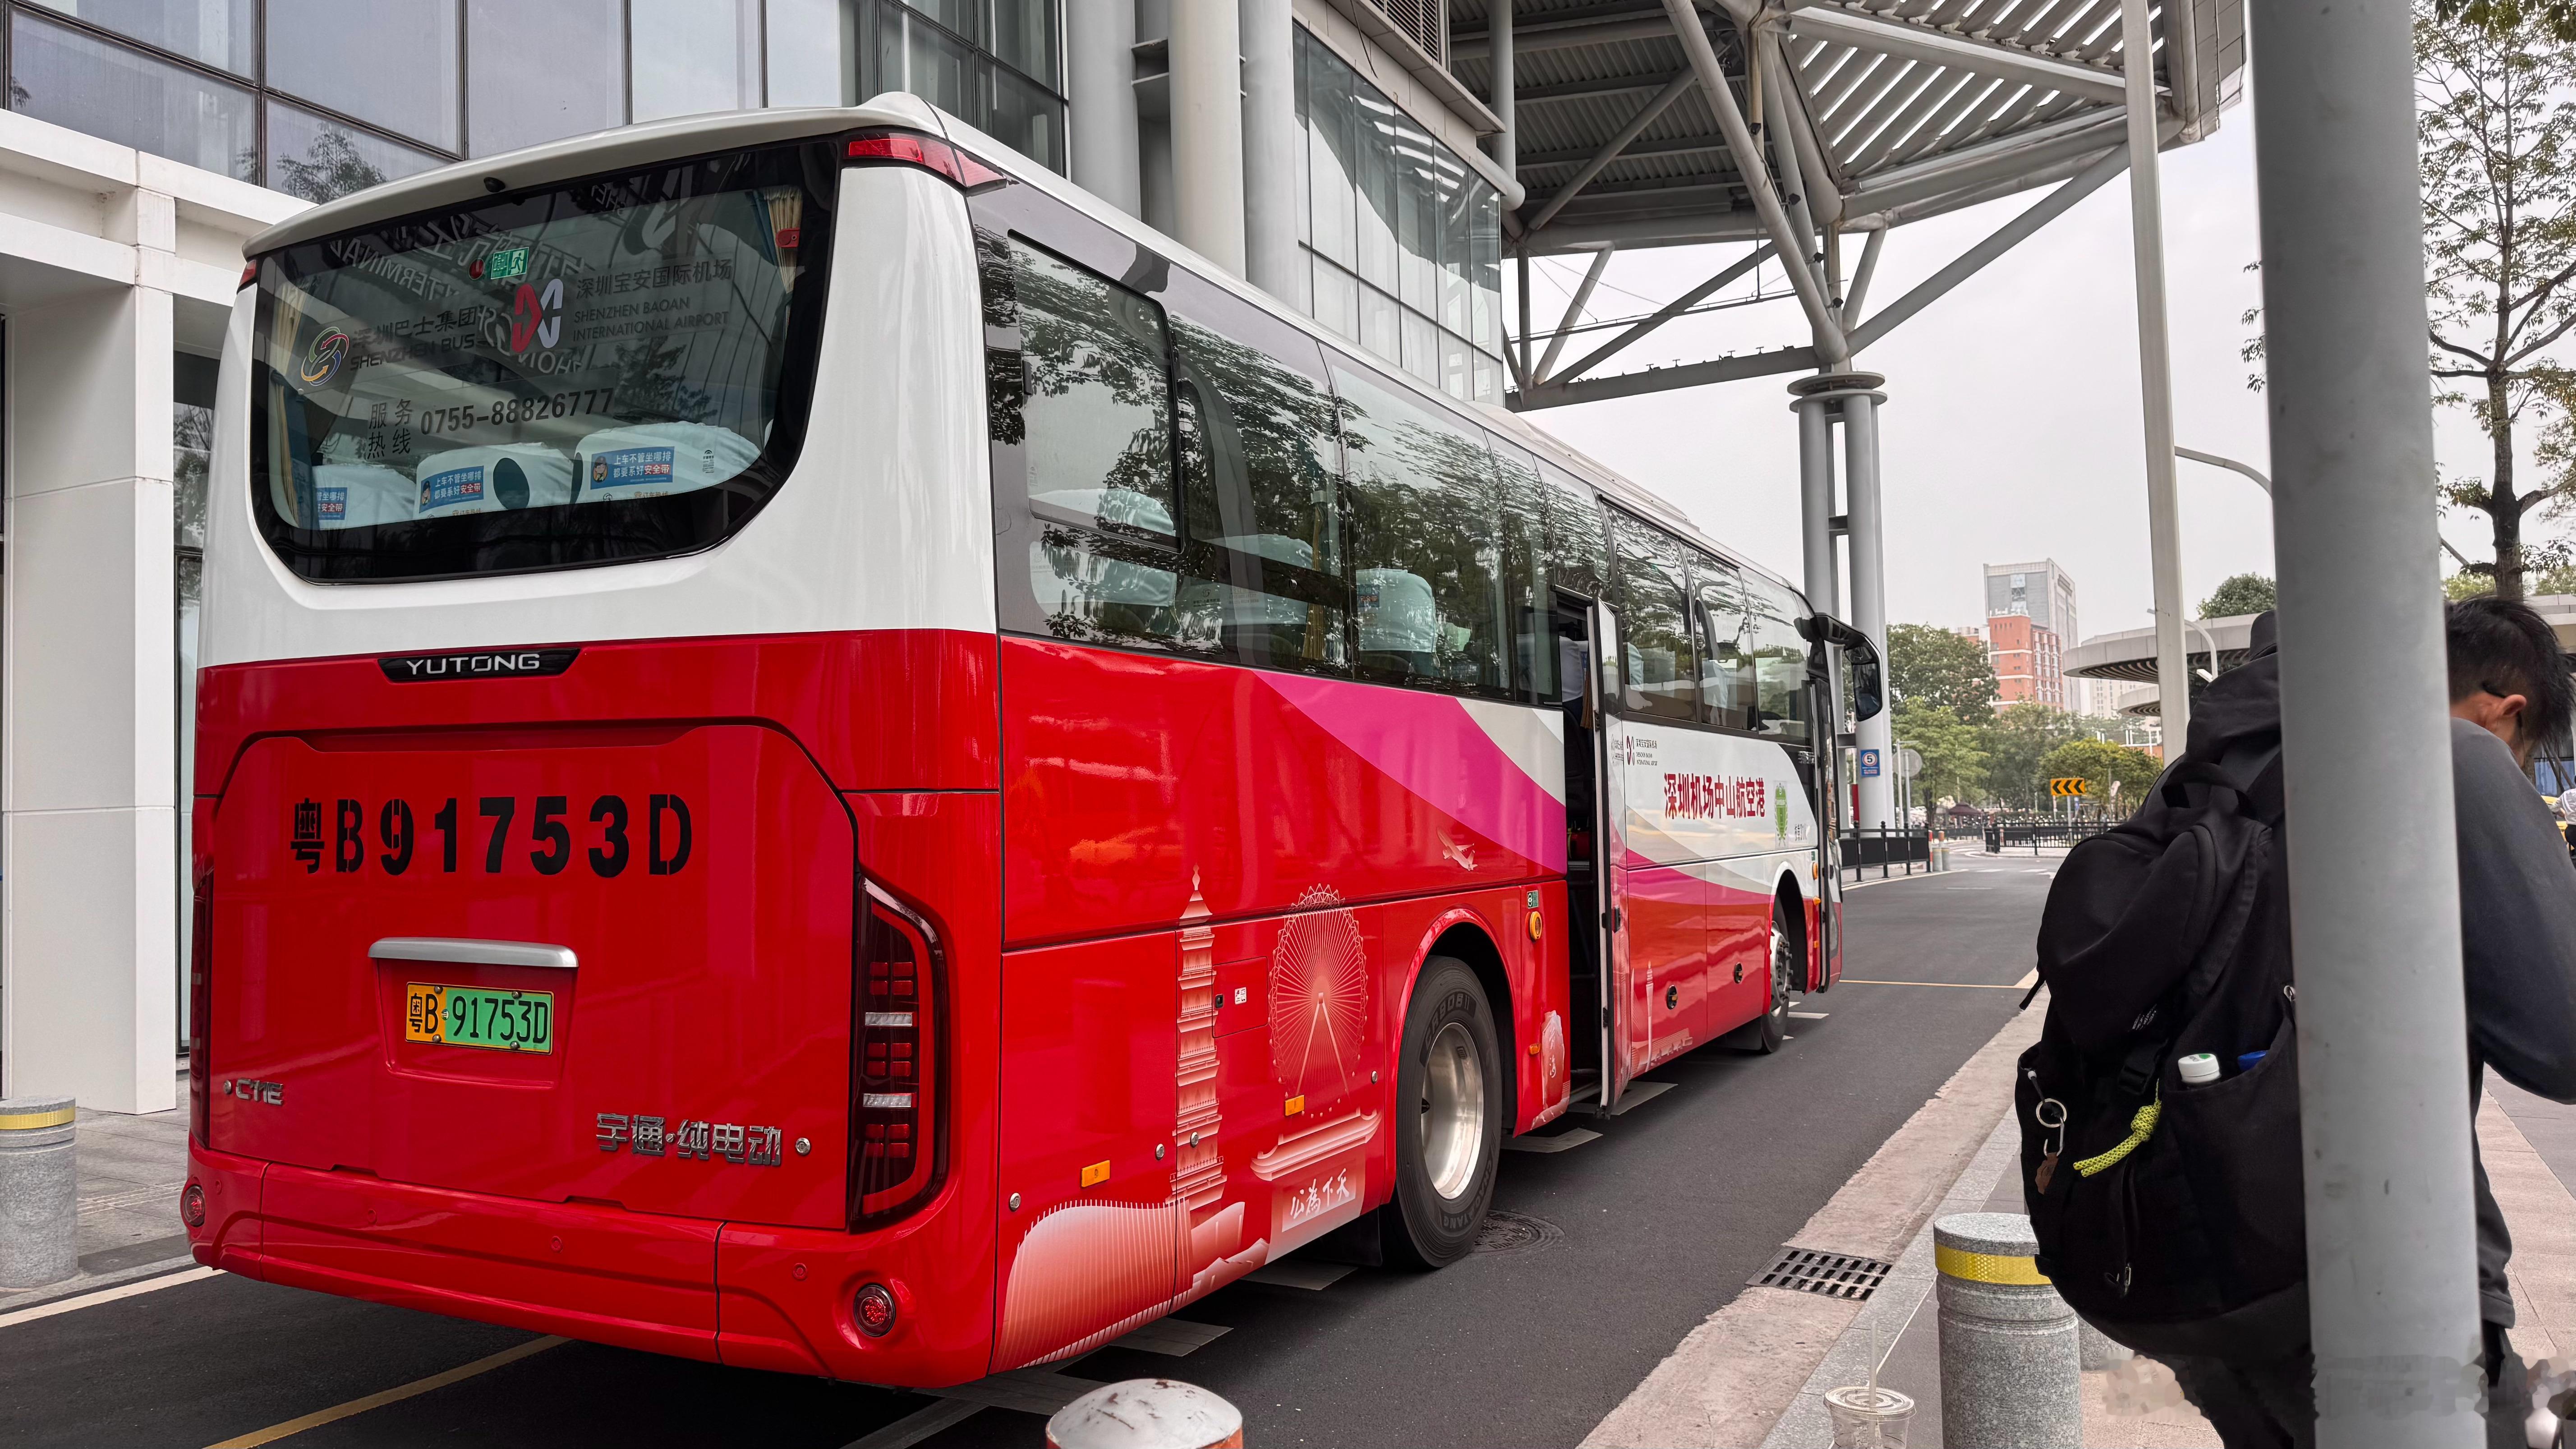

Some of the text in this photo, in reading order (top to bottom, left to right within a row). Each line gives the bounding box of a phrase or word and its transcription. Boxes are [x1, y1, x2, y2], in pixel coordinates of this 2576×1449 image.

[576, 258, 733, 300] 深圳宝安国际机场
[574, 296, 690, 323] SHENZHEN BAOAN
[573, 311, 729, 342] INTERNATIONAL AIRPORT
[441, 333, 476, 354] BUS
[368, 398, 413, 429] 服务
[420, 387, 614, 435] 0755-88826777
[367, 428, 412, 460] 热线
[614, 451, 672, 465] 上车不管坐哪排
[406, 653, 541, 676] YUTONG
[1664, 772, 1765, 819] 深圳机场中山航空港
[290, 794, 692, 878] 粤B91753D
